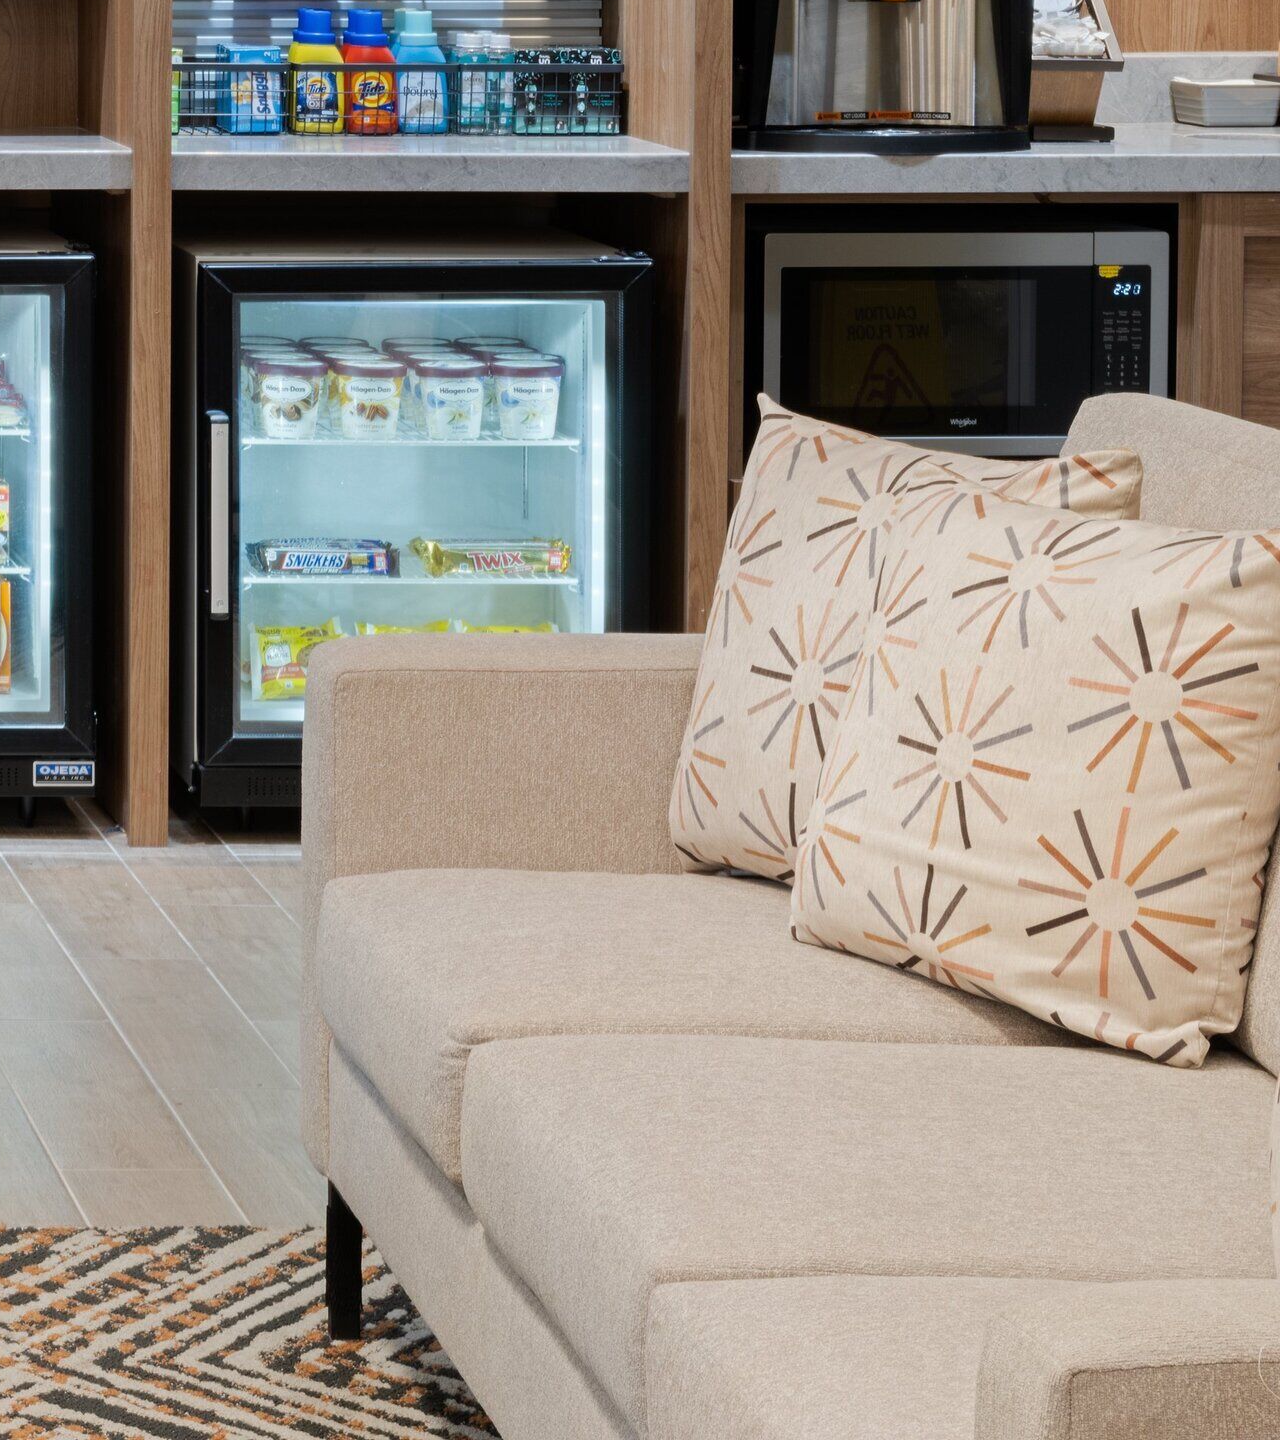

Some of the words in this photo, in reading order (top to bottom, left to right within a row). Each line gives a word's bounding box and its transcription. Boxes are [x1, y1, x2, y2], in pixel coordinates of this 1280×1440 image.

[358, 80, 386, 100] Tide
[1113, 284, 1141, 296] 2:20
[285, 553, 346, 568] SNICKERS
[467, 550, 525, 570] TWIX
[39, 765, 89, 775] OJEDA
